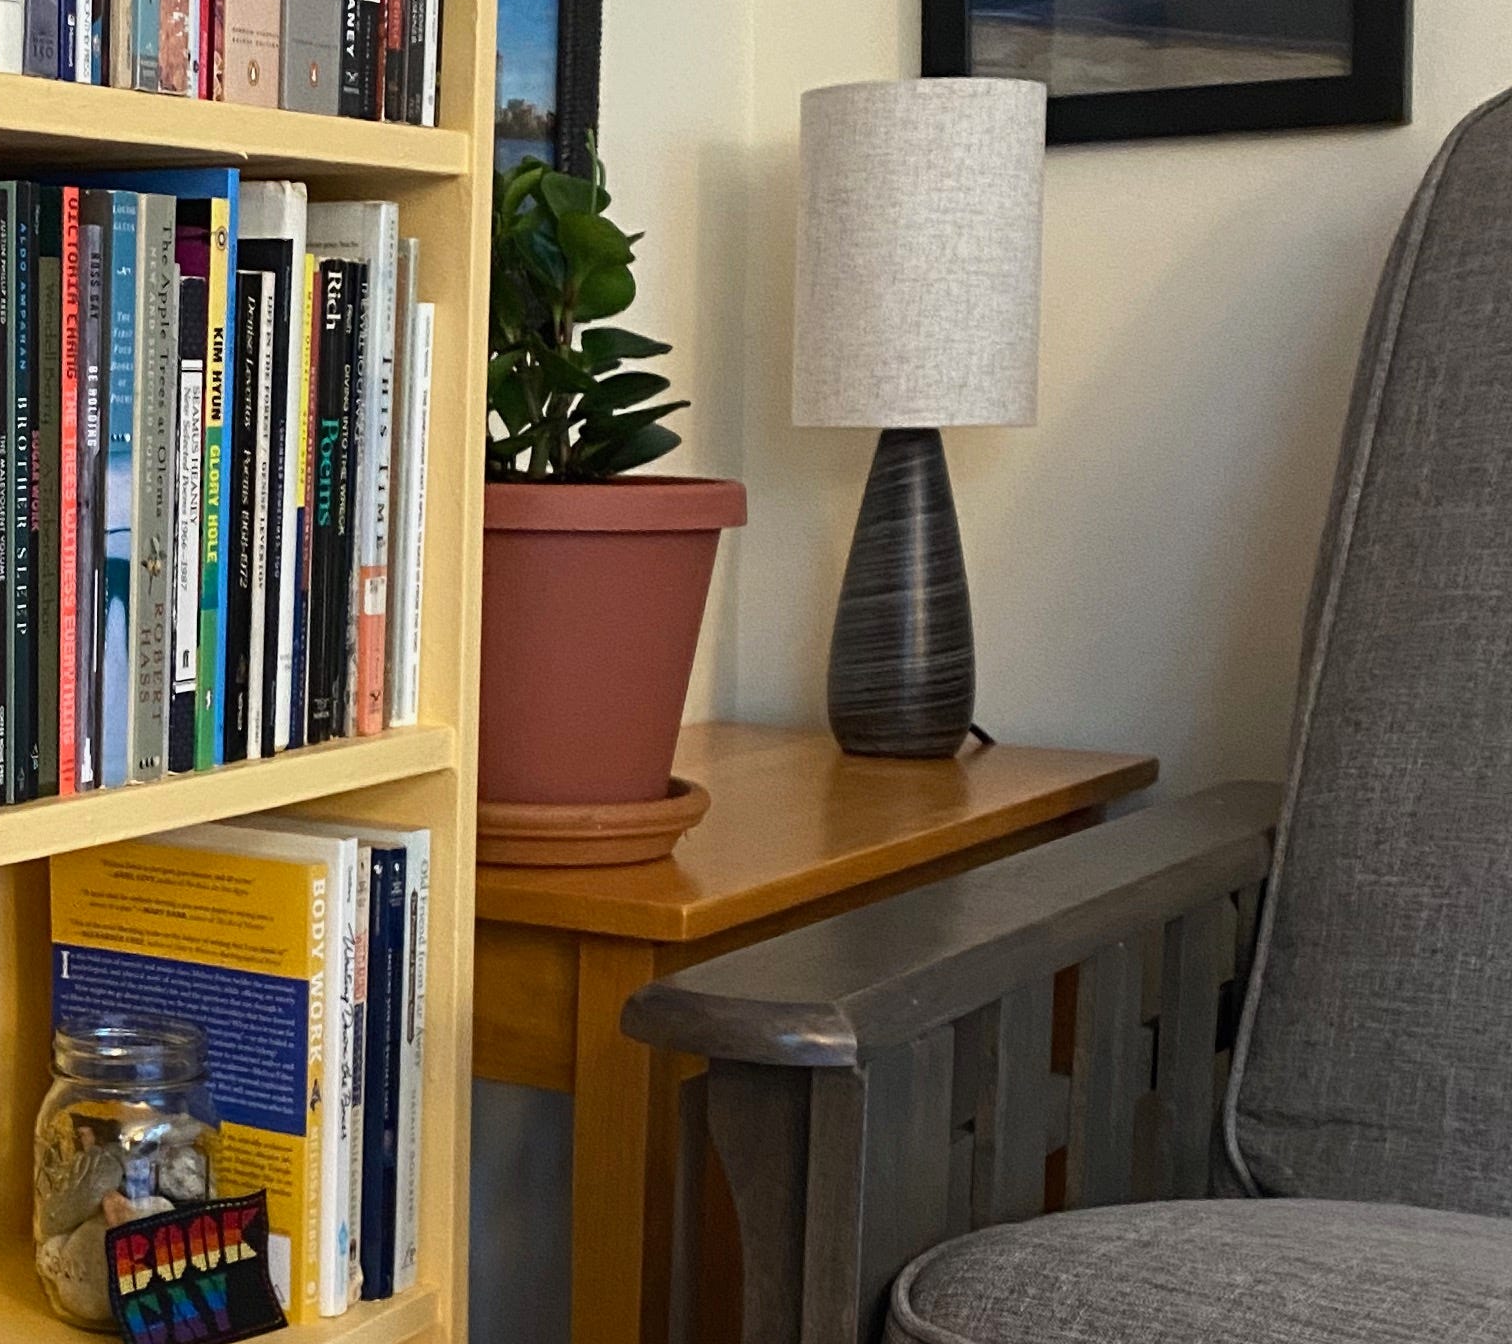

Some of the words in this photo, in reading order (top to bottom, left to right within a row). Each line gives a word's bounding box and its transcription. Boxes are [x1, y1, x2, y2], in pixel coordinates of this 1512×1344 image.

[67, 197, 78, 305] VICTORIA
[161, 225, 171, 265] The
[158, 275, 170, 344] Apple
[326, 270, 343, 330] Rich
[67, 313, 77, 379] CHANG
[212, 327, 223, 363] KIM
[66, 390, 76, 429] THE
[157, 355, 168, 408] Trees
[210, 370, 223, 420] HYUN
[380, 355, 392, 438] THIS
[157, 416, 167, 435] at
[191, 386, 200, 453] SEAMUS
[16, 397, 28, 528] BROTHER
[65, 437, 76, 505] TREES
[156, 445, 167, 517] Olema
[189, 458, 200, 525] HEANEY
[209, 445, 220, 508] GLORY
[317, 418, 339, 526] Poems
[207, 515, 218, 562] HOLE
[377, 465, 390, 549] TIME
[16, 547, 28, 636] SLEEP
[63, 511, 74, 607] WITNESS
[63, 614, 74, 745] EVERYTHING
[139, 627, 151, 703] HASS
[151, 602, 164, 722] ROBERT
[311, 879, 326, 959] BODY
[341, 923, 355, 1003] Writing
[311, 972, 324, 1064] WORK
[342, 1004, 354, 1057] Down
[342, 1064, 354, 1088] the
[340, 1093, 350, 1140] Bones
[308, 1125, 318, 1202] MELISSA
[115, 1208, 258, 1295] BOOK
[308, 1209, 318, 1264] FEBOS
